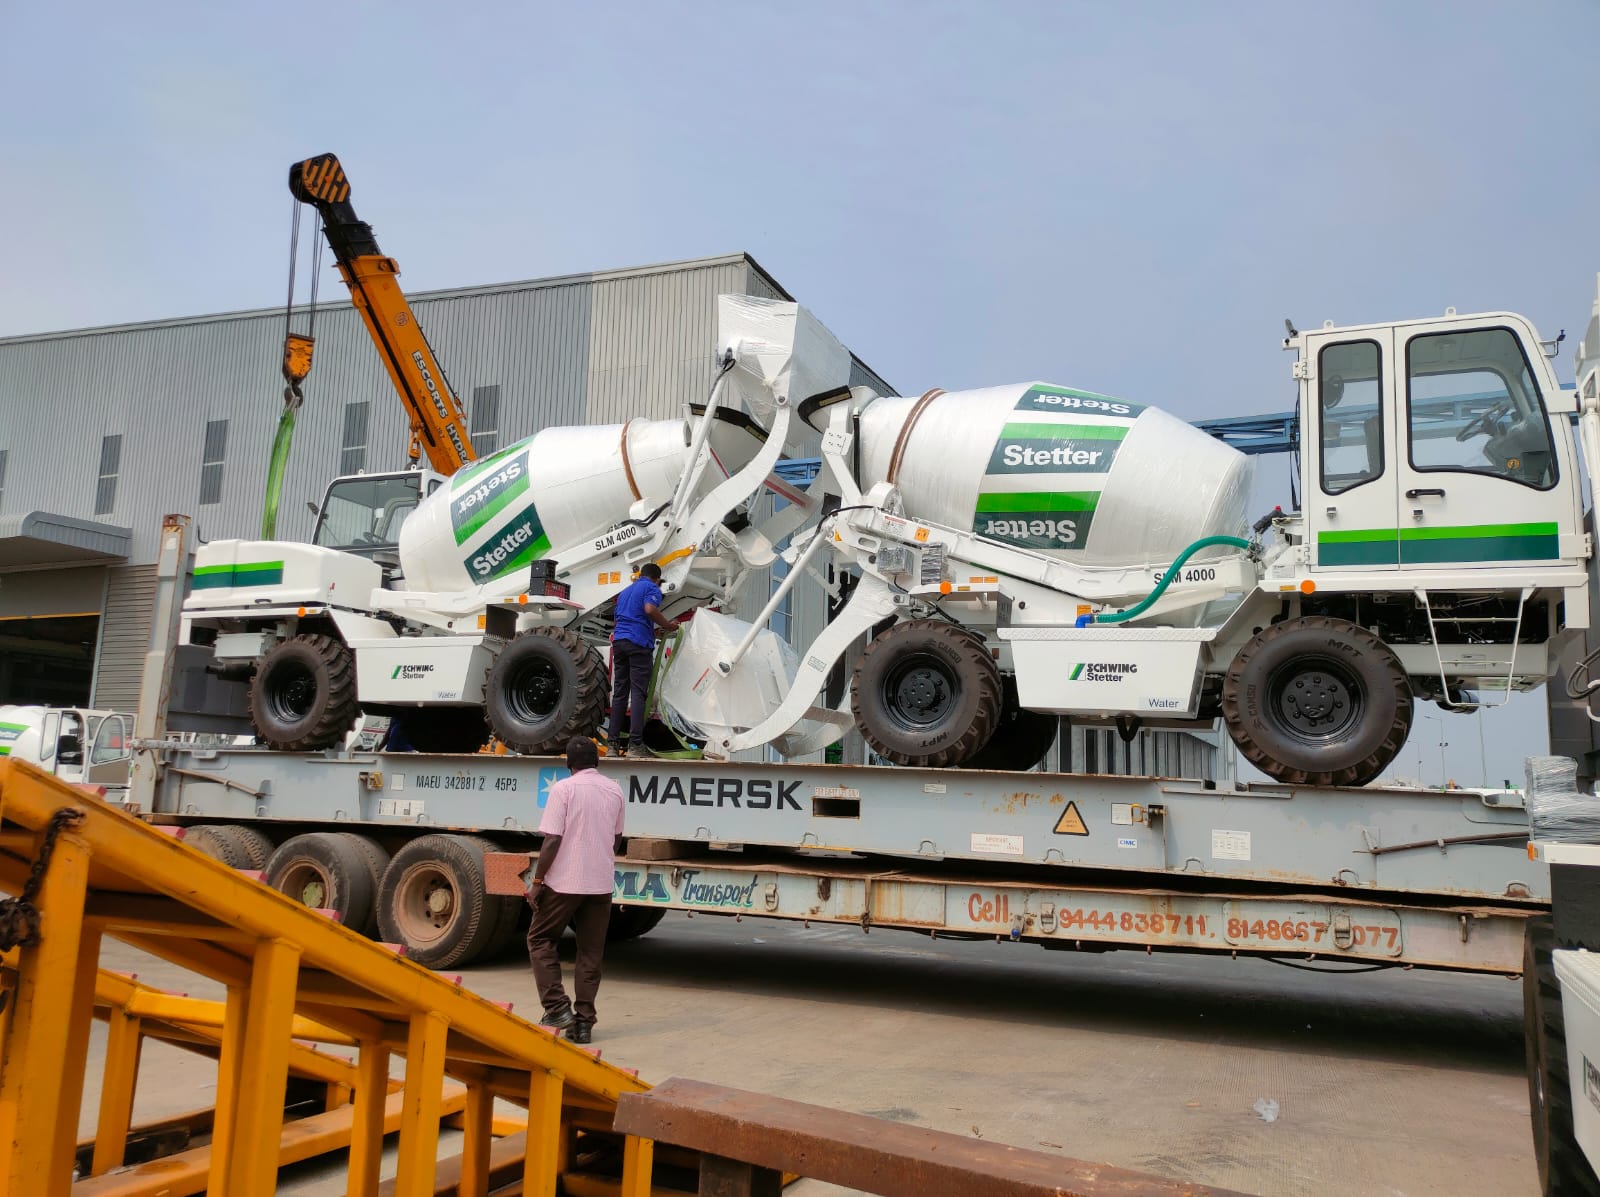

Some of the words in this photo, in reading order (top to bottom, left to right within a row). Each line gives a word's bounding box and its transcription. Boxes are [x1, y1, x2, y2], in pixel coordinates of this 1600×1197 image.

[412, 351, 448, 419] ESCORTS
[1033, 394, 1130, 414] Stetter
[1003, 444, 1102, 466] Stetter
[458, 462, 521, 514] Stetter
[595, 535, 615, 551] SLM
[616, 526, 637, 542] 4000
[984, 519, 1077, 543] Stetter
[472, 521, 533, 575] Stetter
[1153, 571, 1182, 585] SM
[1185, 568, 1216, 582] 4000
[1328, 639, 1363, 658] MPT
[402, 664, 434, 672] SCHWING
[1087, 663, 1138, 673] SCHWING
[1087, 672, 1123, 682] Stetter
[1148, 698, 1180, 709] Water
[416, 775, 441, 789] MAEU
[444, 776, 476, 790] 342881
[478, 776, 487, 791] 2
[494, 777, 518, 792] 45P3
[628, 775, 804, 811] MAERSK
[681, 869, 758, 907] Transport
